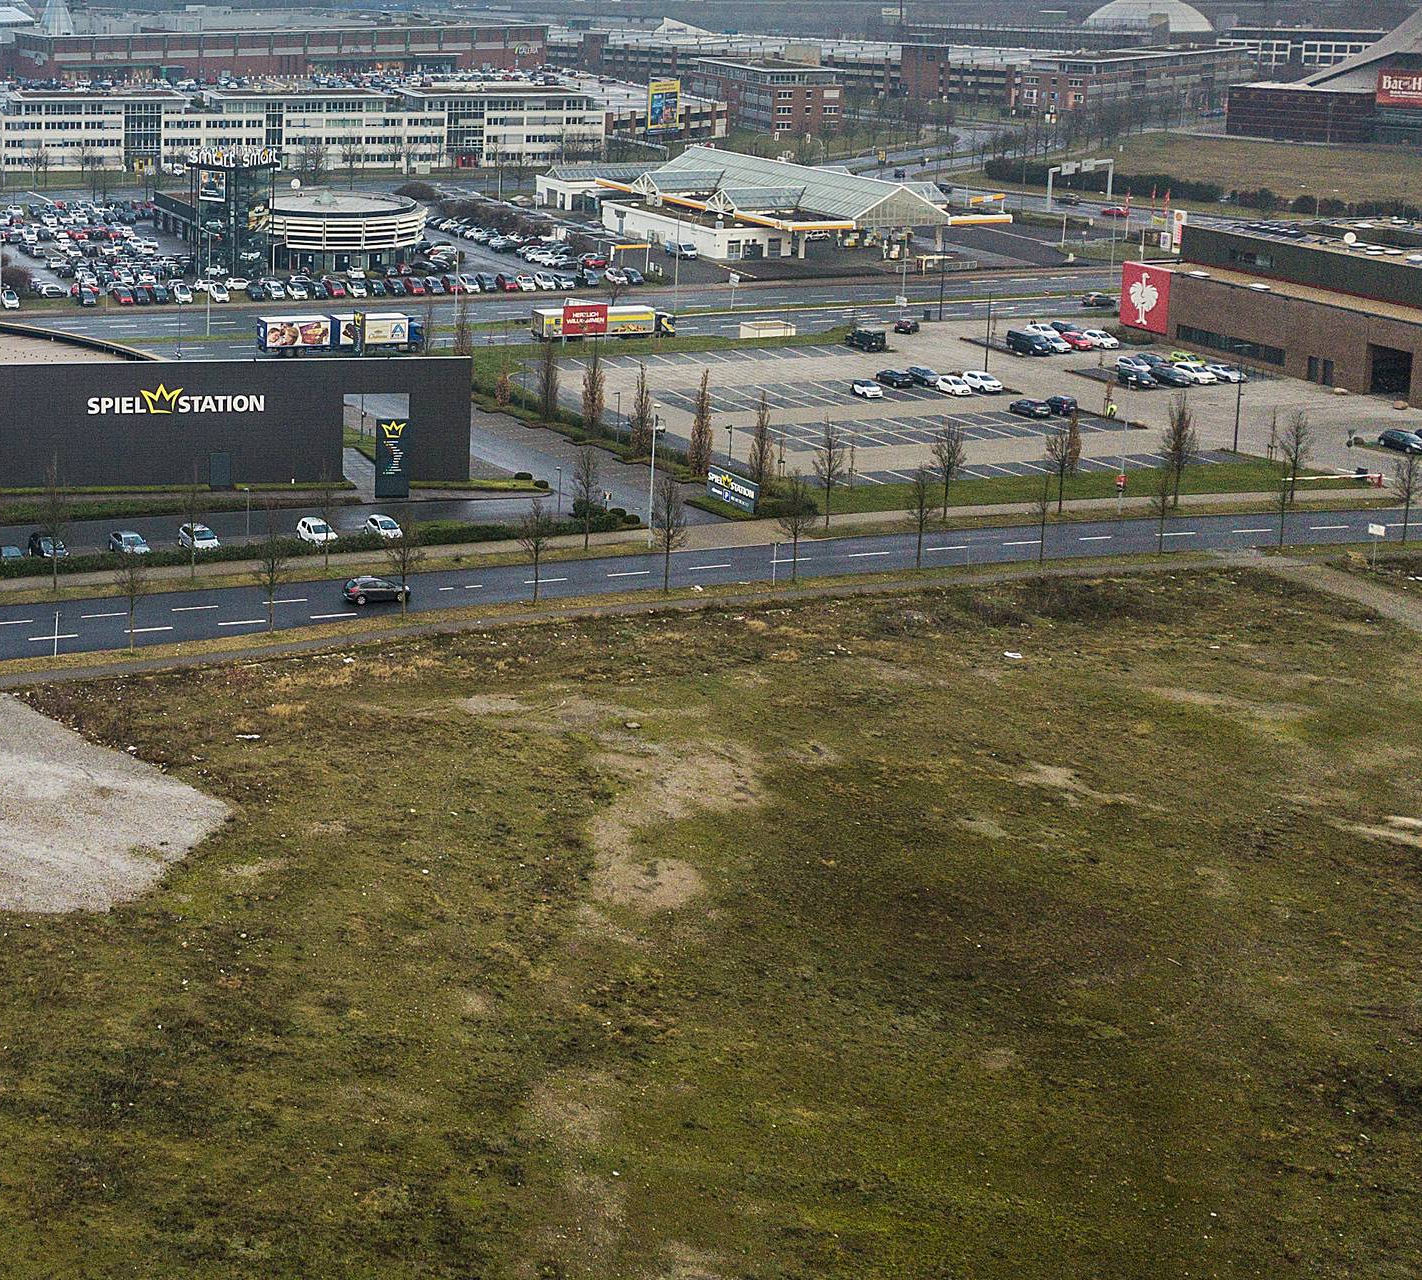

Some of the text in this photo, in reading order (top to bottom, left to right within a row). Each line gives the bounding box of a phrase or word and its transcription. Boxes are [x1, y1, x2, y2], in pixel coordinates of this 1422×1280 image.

[87, 394, 265, 415] SPIEL STATION
[708, 472, 723, 486] SPIEL
[729, 481, 755, 500] STATION
